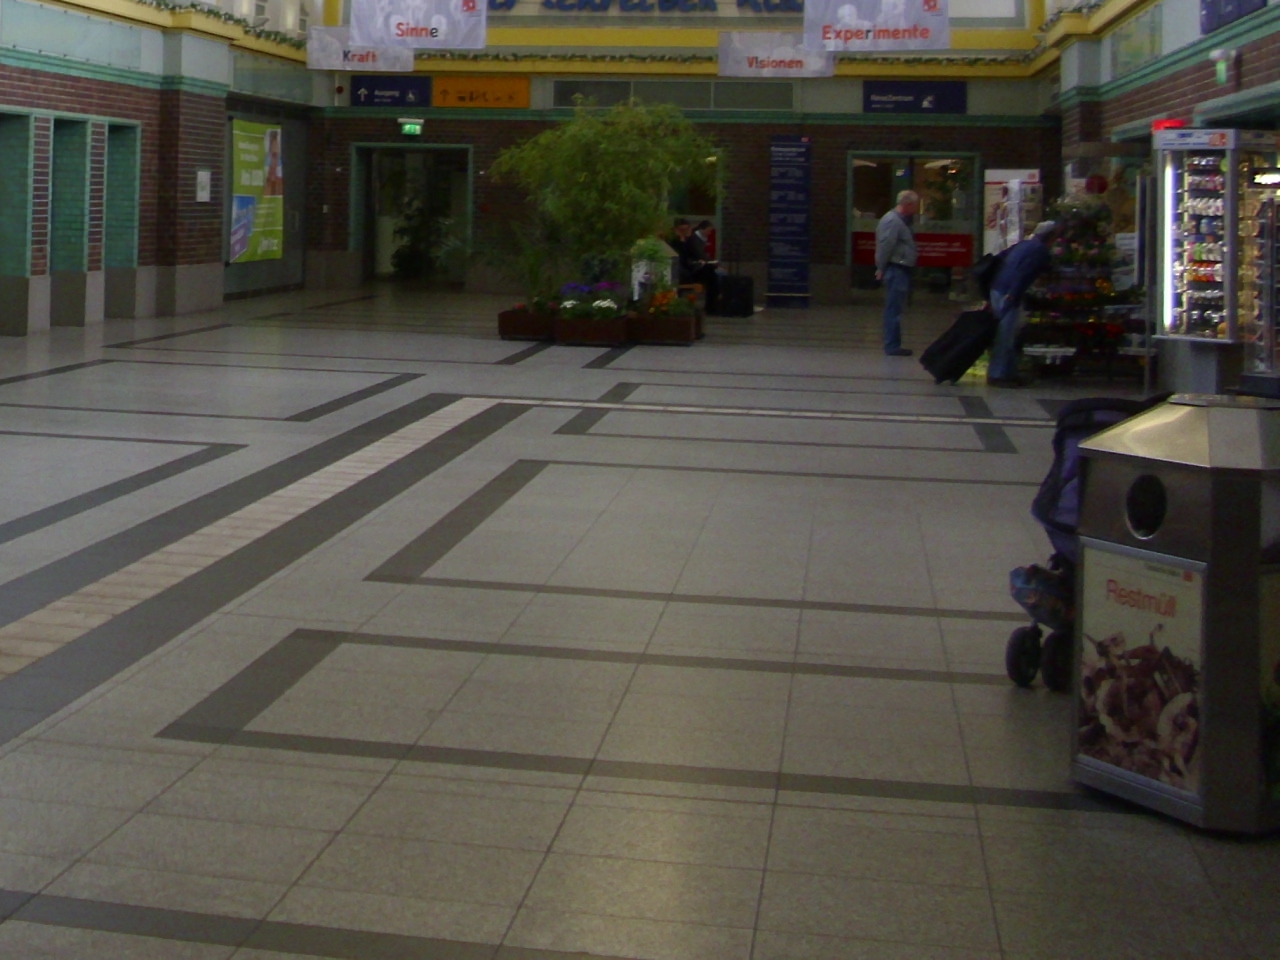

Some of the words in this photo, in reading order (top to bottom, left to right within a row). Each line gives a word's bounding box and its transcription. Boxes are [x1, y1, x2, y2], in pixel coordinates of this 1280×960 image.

[395, 22, 439, 38] Sinne
[822, 25, 930, 43] Experimente
[342, 50, 378, 63] Kraft
[747, 56, 804, 69] Visionen
[1106, 578, 1176, 617] Restmüll
